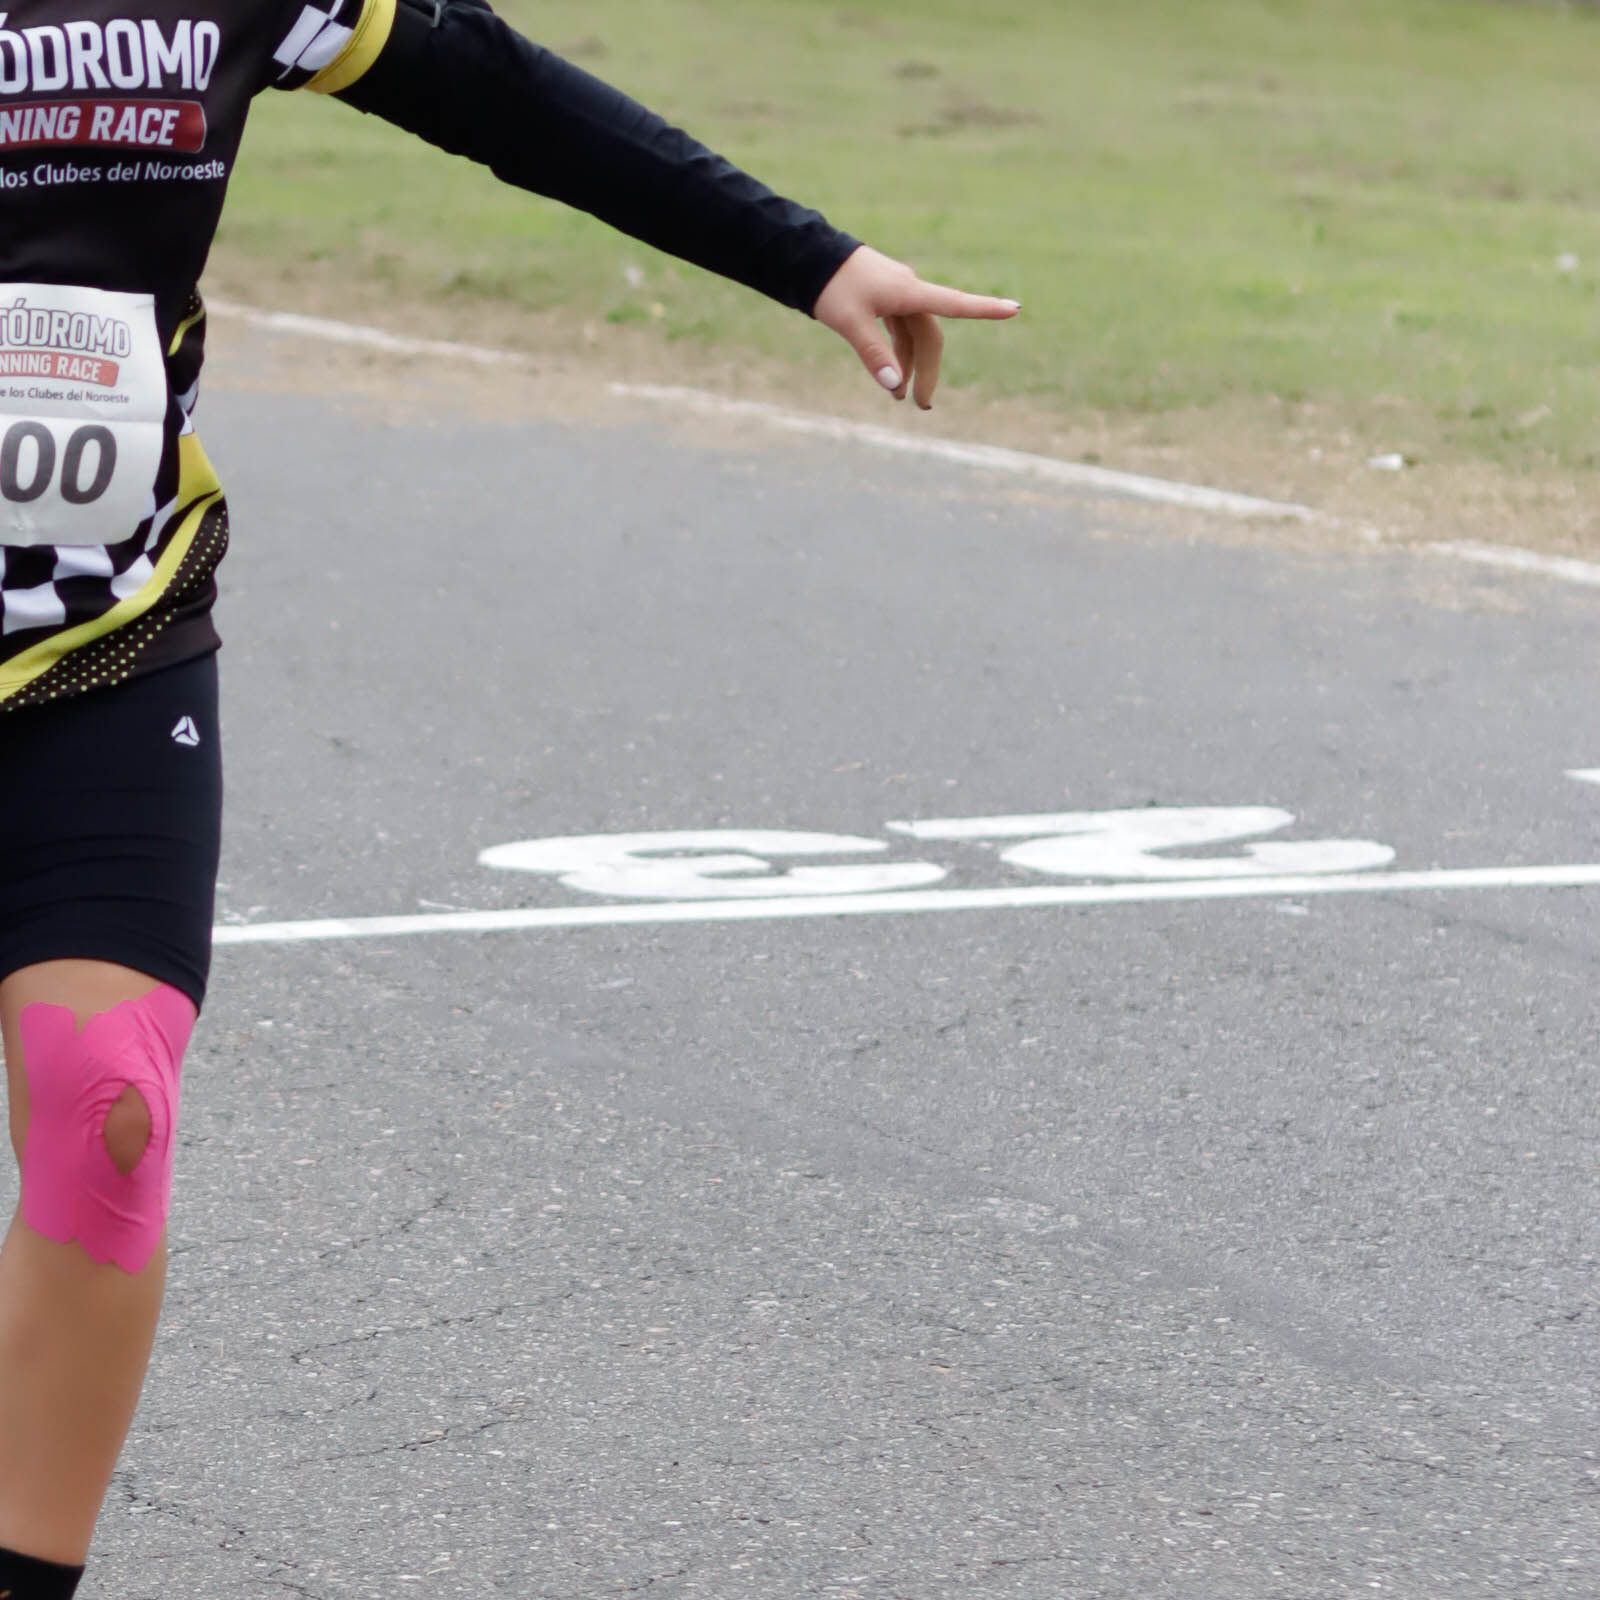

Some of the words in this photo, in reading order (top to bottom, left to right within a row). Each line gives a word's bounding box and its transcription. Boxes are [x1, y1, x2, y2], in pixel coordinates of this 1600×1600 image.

[90, 106, 180, 146] RACE
[0, 167, 28, 189] los
[33, 162, 100, 186] Clubes
[107, 162, 141, 182] del
[144, 159, 225, 181] Noroeste
[56, 354, 102, 382] RACE
[9, 386, 25, 399] los
[27, 387, 64, 400] Clubes
[66, 388, 83, 401] del
[85, 390, 130, 404] Noroeste
